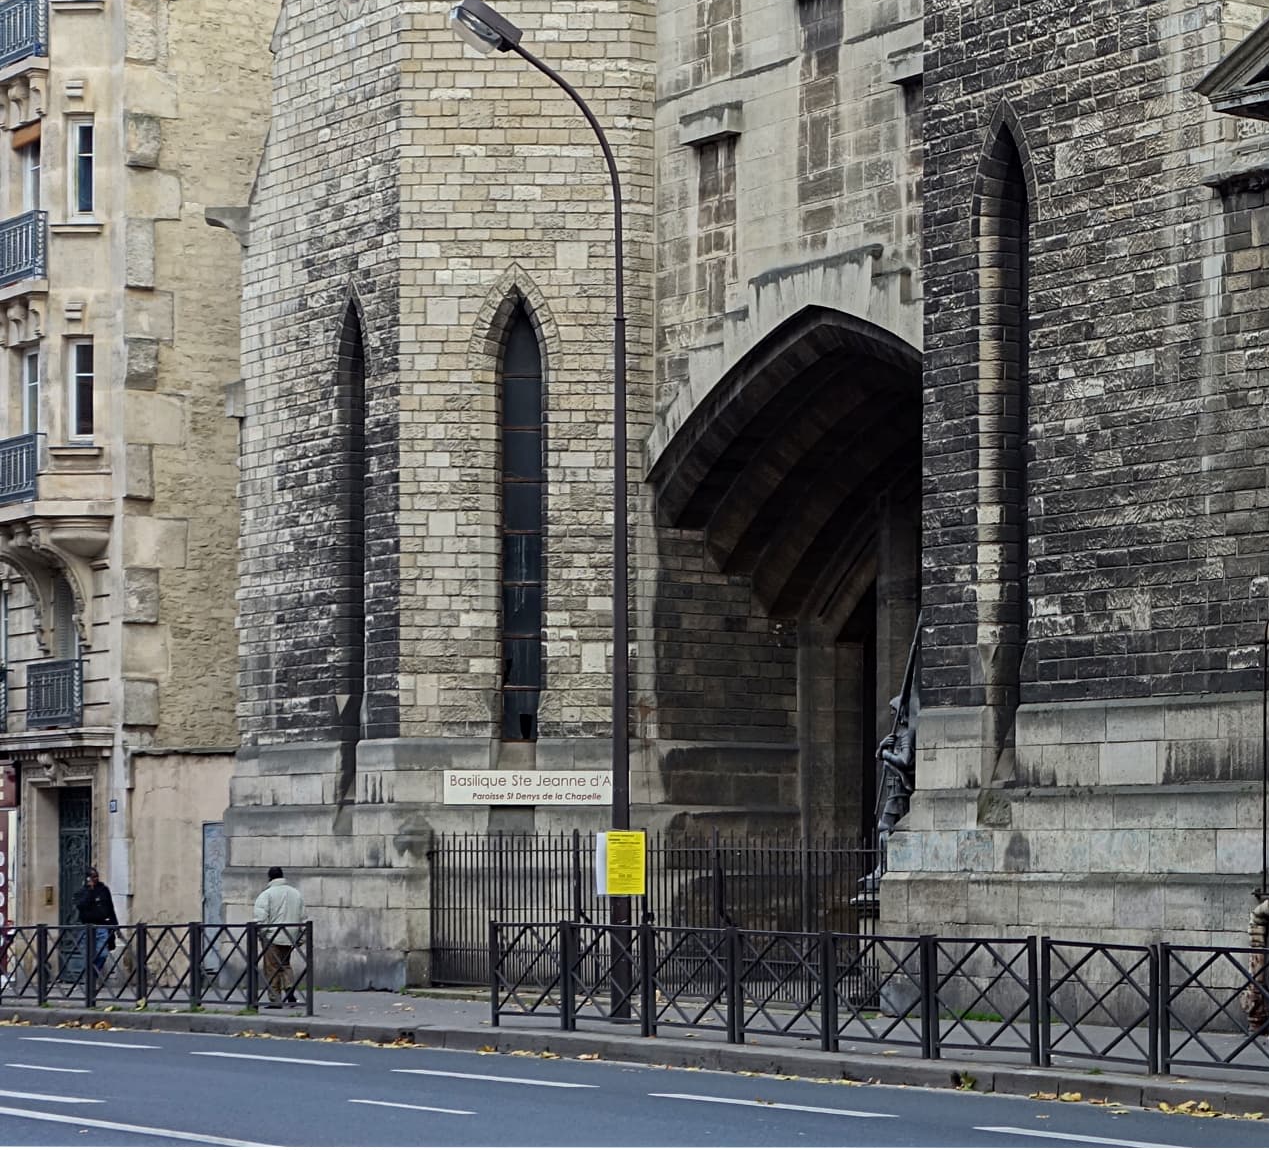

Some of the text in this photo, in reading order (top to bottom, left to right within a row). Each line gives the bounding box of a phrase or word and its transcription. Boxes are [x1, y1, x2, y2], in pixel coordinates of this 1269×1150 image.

[450, 774, 612, 789] Basilique Ste Jeanne d'A
[472, 792, 602, 802] Paroisse St Denys de la Chapelle
